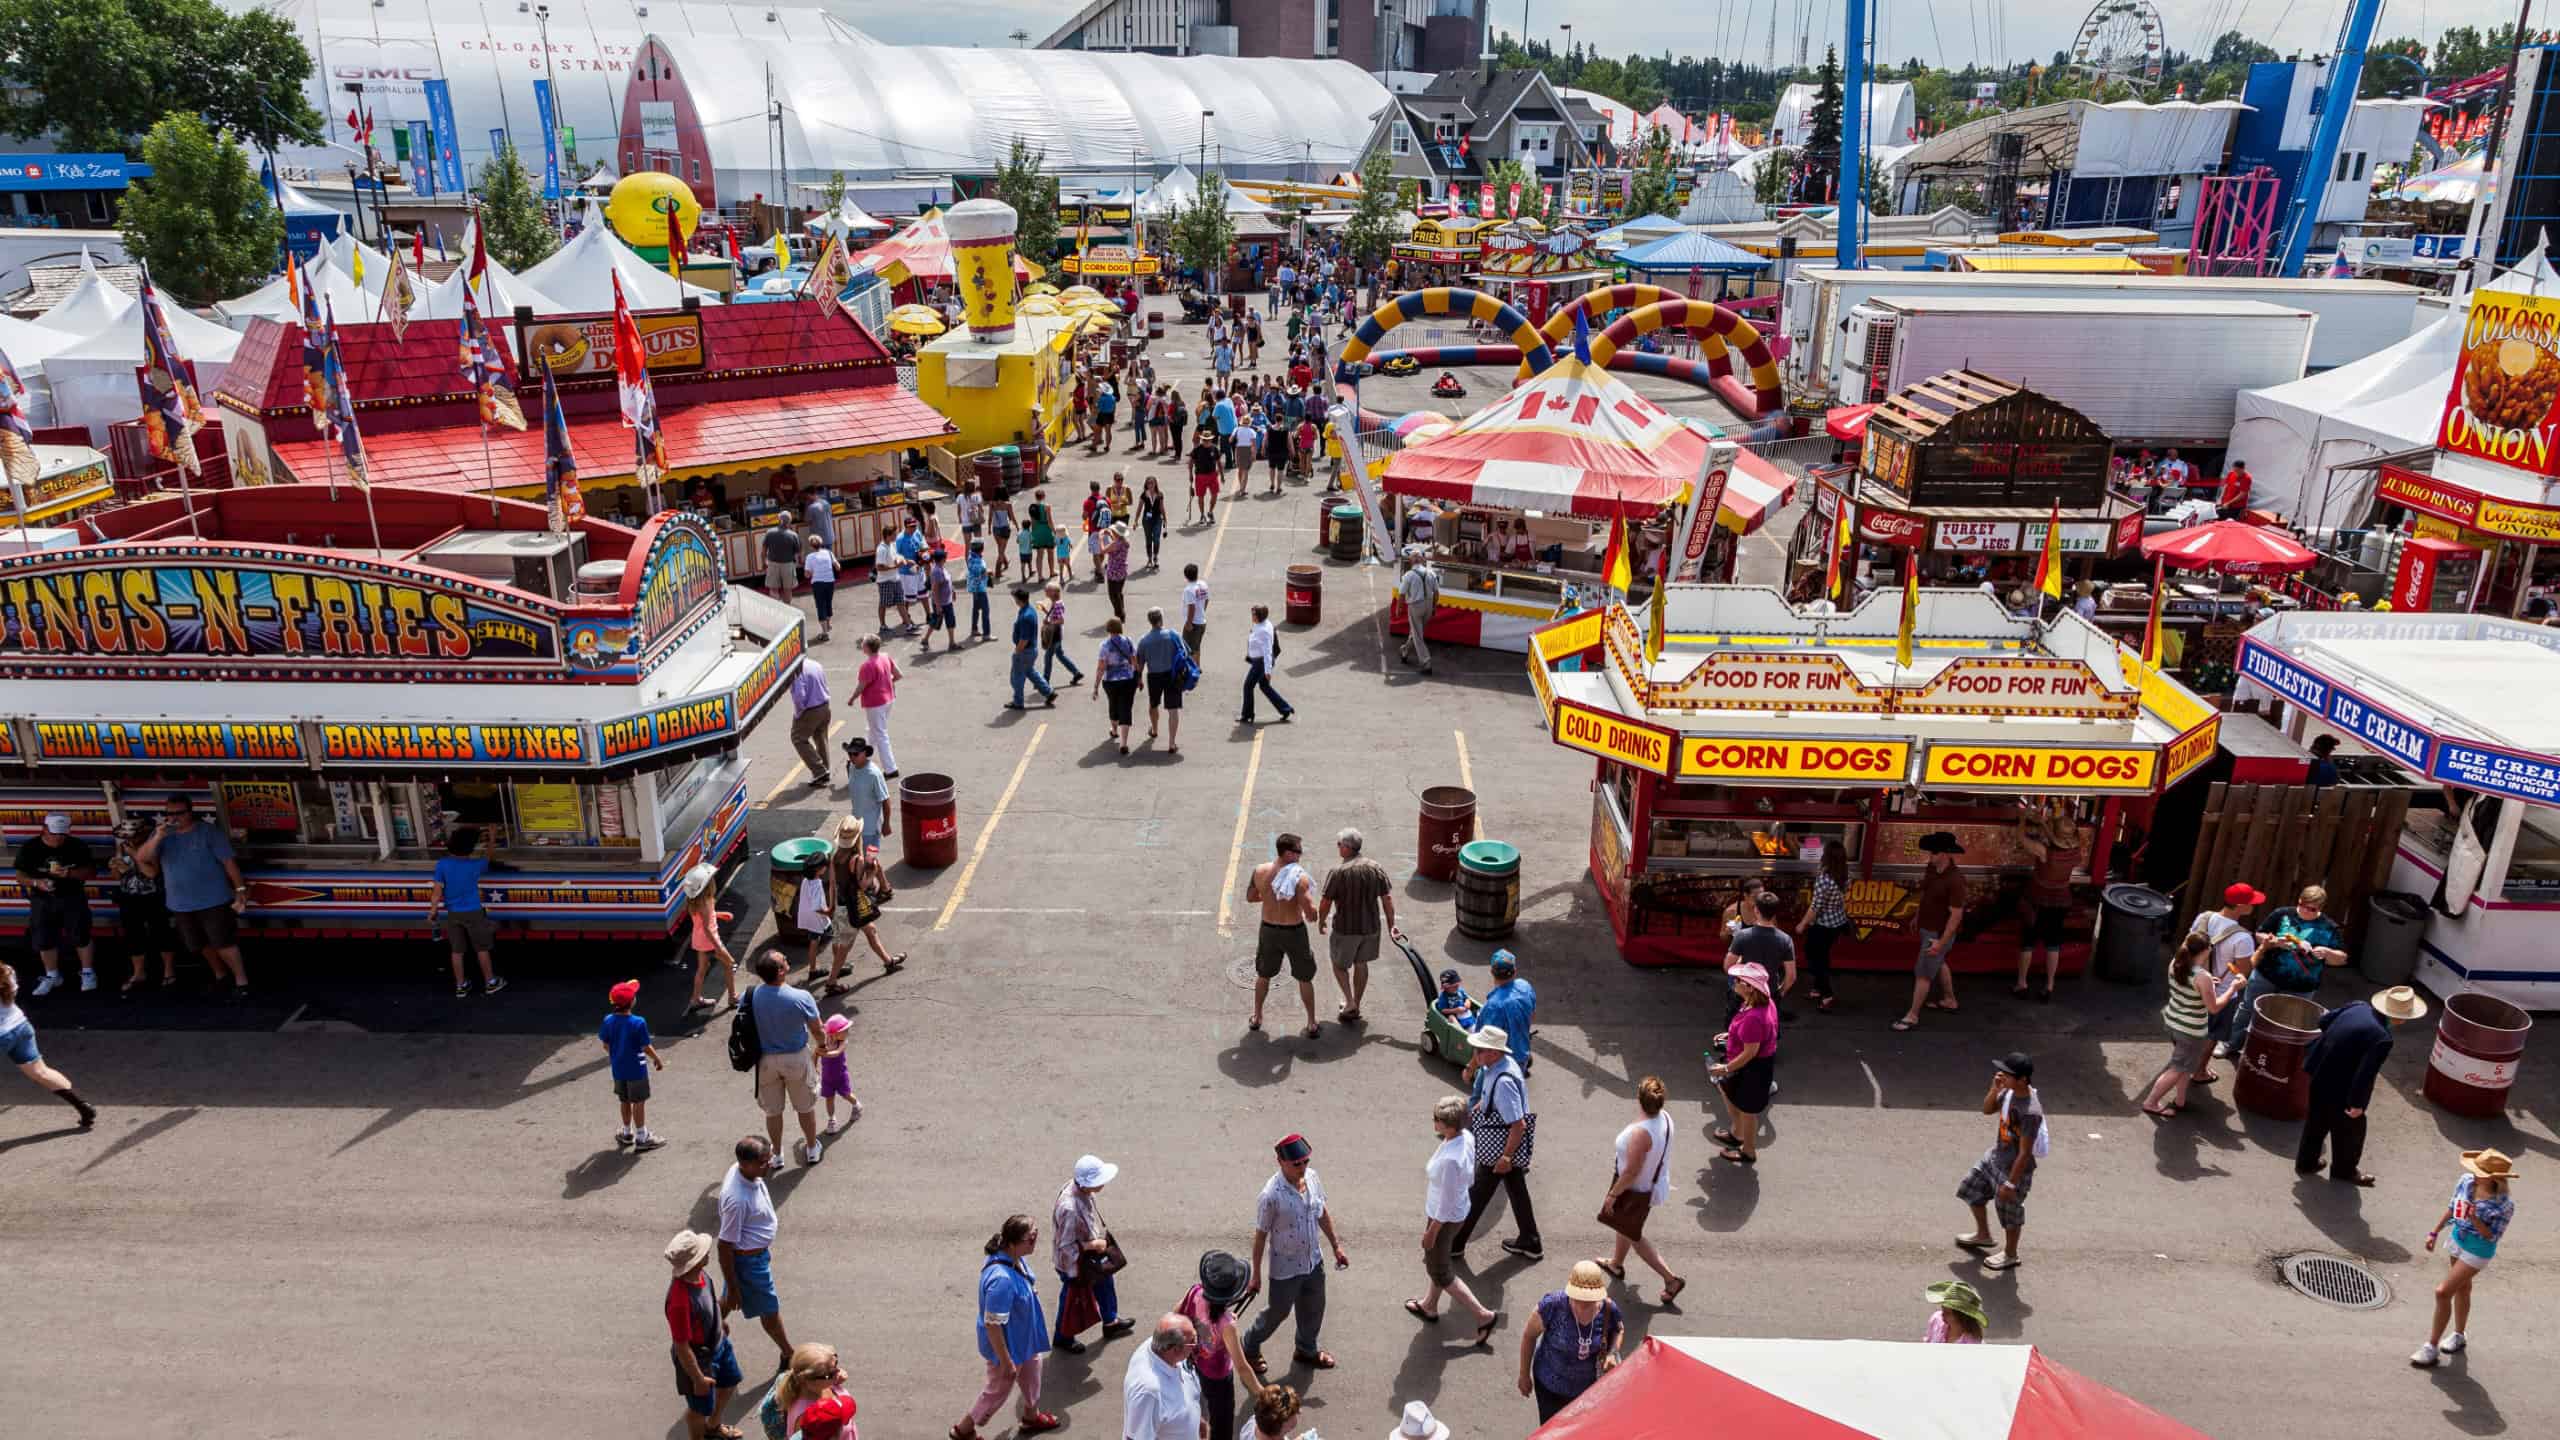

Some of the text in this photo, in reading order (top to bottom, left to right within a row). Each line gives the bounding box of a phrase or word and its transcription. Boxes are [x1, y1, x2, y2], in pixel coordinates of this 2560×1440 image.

[461, 41, 577, 54] CALGARY
[530, 58, 540, 70] &
[335, 68, 432, 81] GMC
[88, 162, 121, 179] Zone
[1413, 231, 1441, 244] FRIES
[2020, 235, 2045, 243] ATCO
[1084, 263, 1106, 271] CORN
[1108, 263, 1129, 271] DOGS
[2521, 296, 2539, 308] THE
[2448, 405, 2556, 470] ONION
[2383, 477, 2474, 516] JUMBO RINGS
[1687, 474, 1725, 555] BURGERS
[1942, 523, 1996, 535] TURKEY
[2497, 522, 2551, 538] ONION
[1982, 538, 2010, 550] LEGS
[2073, 539, 2081, 549] &
[2083, 540, 2099, 550] DIP
[1703, 670, 1842, 690] FOOD FOR FUN
[1948, 675, 2087, 696] FOOD FOR FUN
[2248, 649, 2325, 708] FIDDLESTIX
[604, 698, 726, 758] COLD DRINKS
[2334, 695, 2425, 763] ICE CREAM
[232, 724, 298, 759] FRIES
[324, 726, 582, 760] BONELESS WINGS
[1566, 714, 1662, 764] COLD DRINKS
[1696, 745, 1892, 772] CORN DOGS
[2167, 726, 2214, 776] COLD DRINKS
[1941, 753, 2140, 780] CORN DOGS
[2448, 748, 2560, 783] ICE CREA
[2448, 761, 2488, 775] DIPPED
[2490, 770, 2503, 778] IN
[2463, 772, 2556, 798] ROLLED IN NUTS
[1861, 918, 1901, 930] DIPPED
